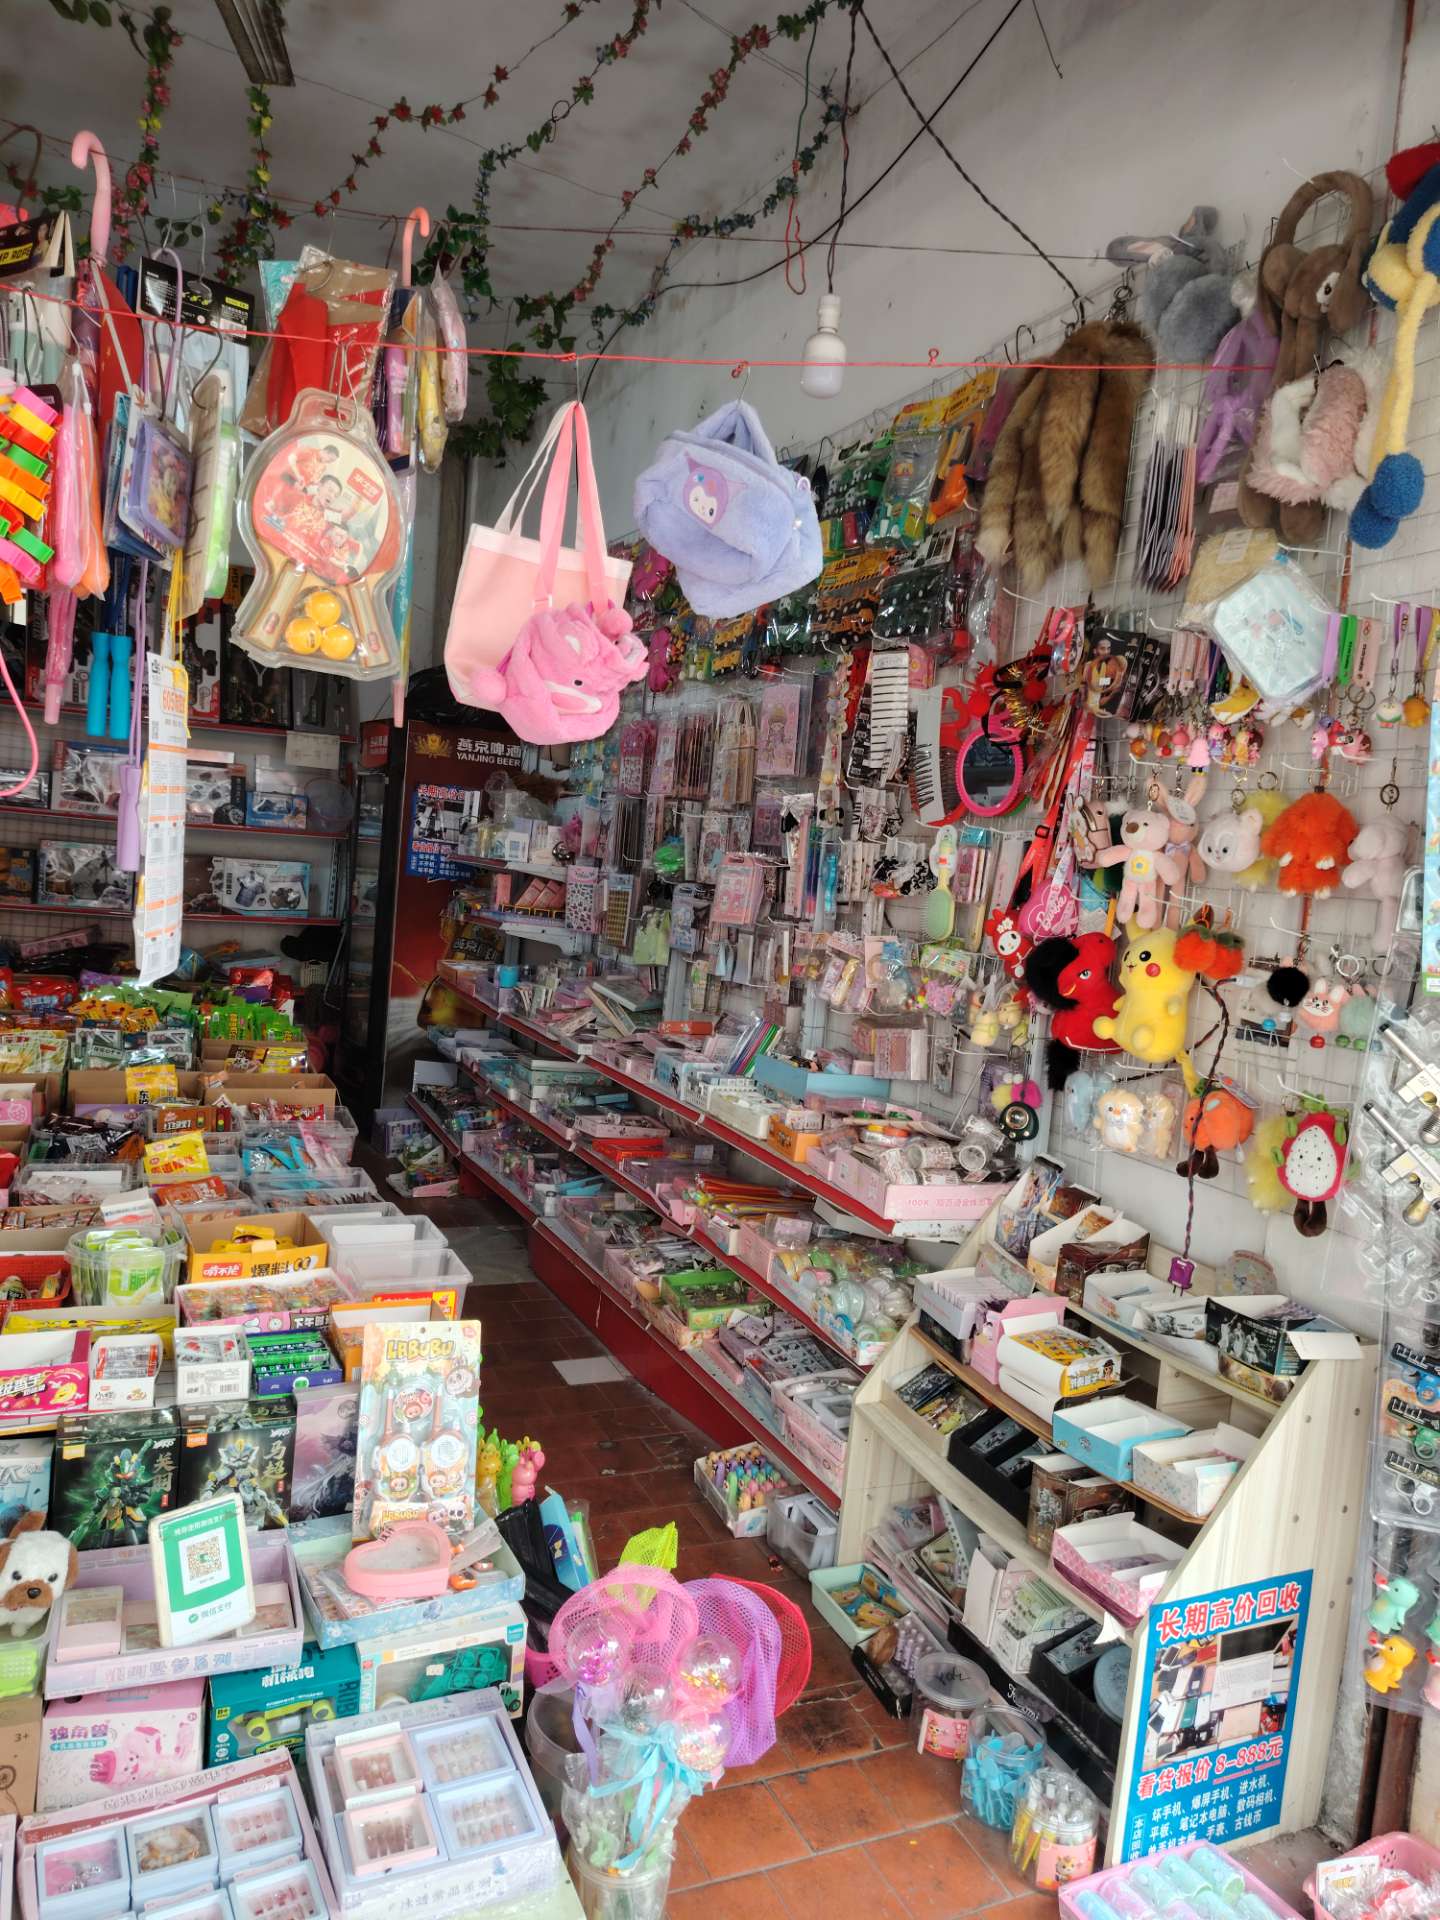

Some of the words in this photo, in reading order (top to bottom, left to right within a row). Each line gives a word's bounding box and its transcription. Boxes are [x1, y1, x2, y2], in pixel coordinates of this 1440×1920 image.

[457, 738, 522, 759] 燕京啤酒
[456, 752, 495, 764] YANJING
[497, 757, 521, 768] BEER
[201, 1601, 232, 1618] 微信支付
[1156, 1581, 1301, 1643] 长期高价回收
[50, 1724, 109, 1742] 独角兽
[1136, 1756, 1211, 1799] 看货报价
